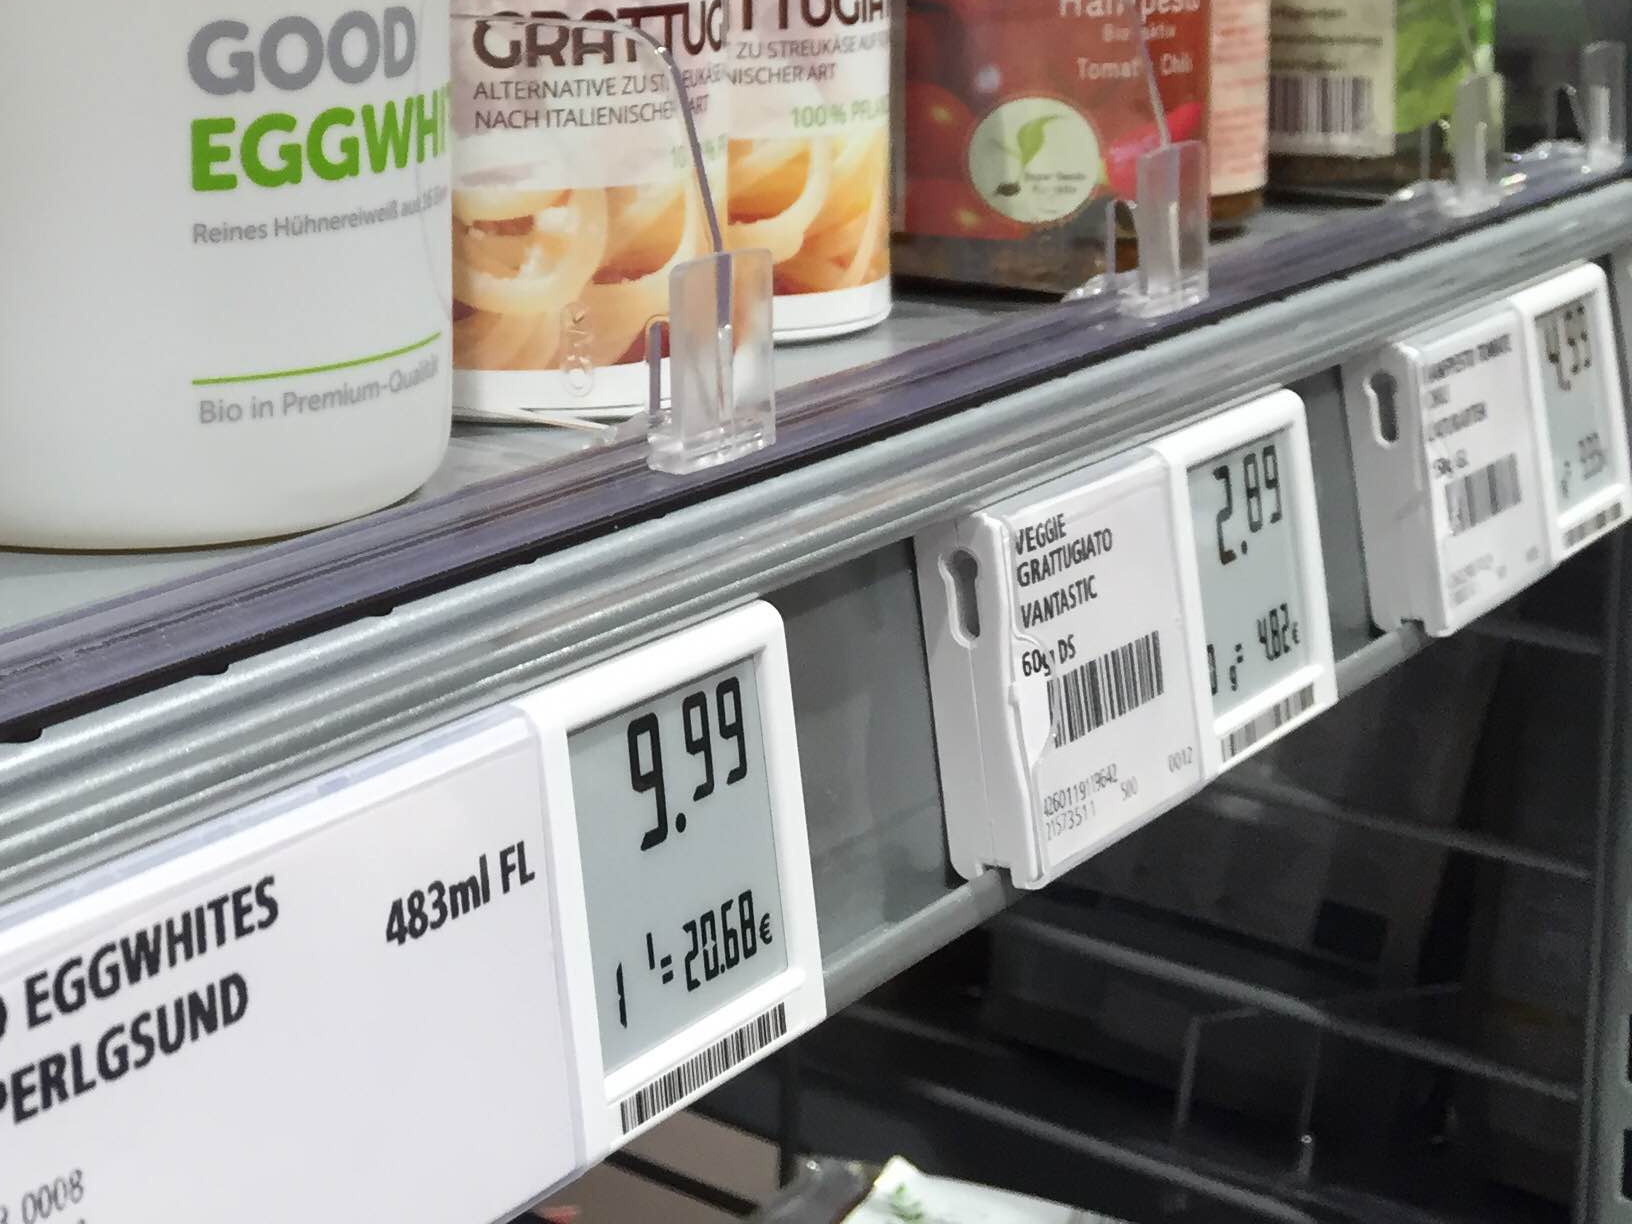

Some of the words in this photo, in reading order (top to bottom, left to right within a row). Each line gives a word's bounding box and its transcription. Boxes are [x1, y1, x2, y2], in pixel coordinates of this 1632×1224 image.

[187, 6, 416, 96] GOOD
[736, 39, 761, 60] ZU
[473, 76, 617, 101] ALTERNATIVE
[621, 74, 647, 95] ZU
[806, 63, 837, 81] ART
[474, 109, 539, 130] NACH
[546, 99, 678, 128] ITALIENISCHE
[791, 104, 826, 128] 100
[192, 222, 268, 246] Reines
[199, 399, 242, 425] Bio
[251, 394, 274, 419] in
[1213, 444, 1283, 565] 2.89
[1015, 512, 1067, 556] VEGGIE
[1017, 527, 1113, 588] GRATTUGIATO
[1020, 574, 1098, 629] VANTASTIC
[1057, 633, 1077, 665] DS
[626, 675, 749, 852] 9.99
[384, 865, 492, 951] 483ml
[499, 838, 537, 895] FL
[25, 874, 280, 1030] EGGWHITES
